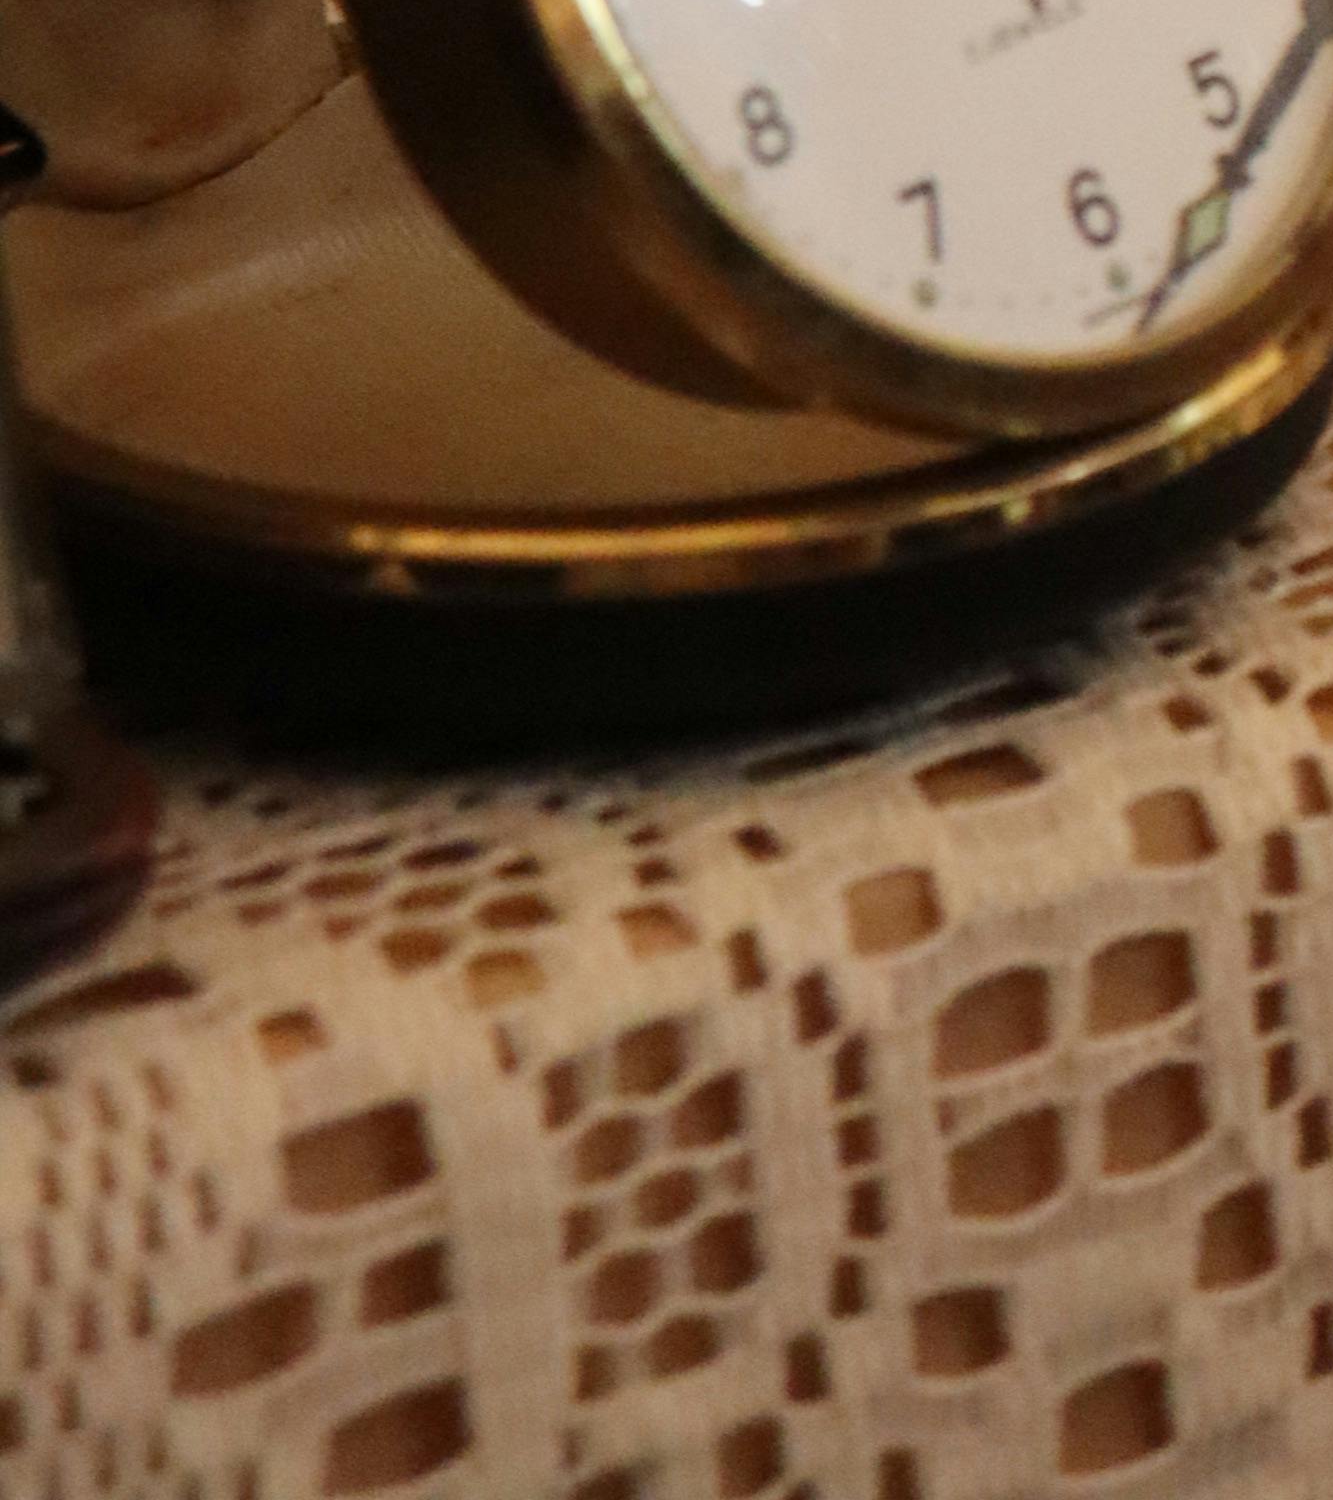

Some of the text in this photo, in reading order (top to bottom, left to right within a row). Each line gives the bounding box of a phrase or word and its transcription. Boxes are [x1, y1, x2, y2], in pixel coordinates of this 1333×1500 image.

[738, 87, 793, 169] 8
[1187, 50, 1242, 128] 5
[898, 179, 944, 263] 7
[1069, 167, 1121, 247] 6
